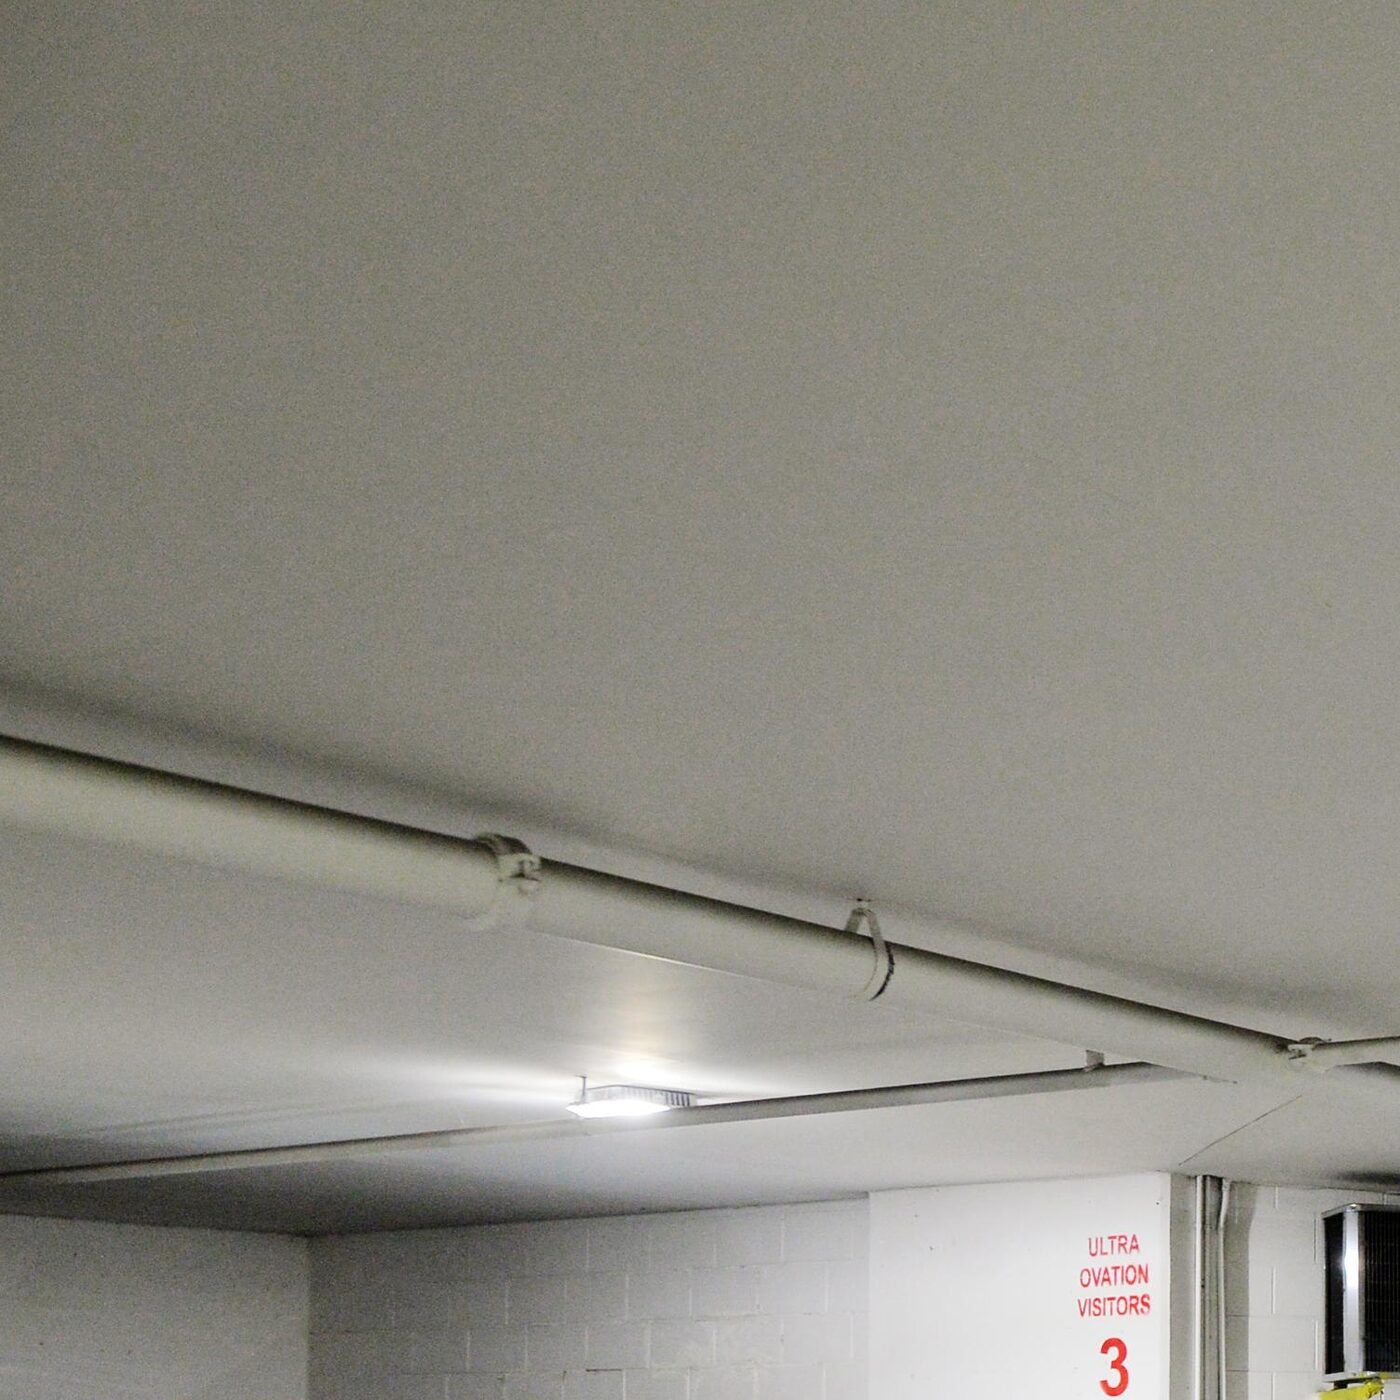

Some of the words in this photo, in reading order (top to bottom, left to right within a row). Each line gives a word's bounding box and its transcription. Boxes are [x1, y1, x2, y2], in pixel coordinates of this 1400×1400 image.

[1088, 1234, 1140, 1257] ULTRA
[1080, 1264, 1149, 1288] OVATION
[1078, 1294, 1151, 1317] VISITORS
[1100, 1337, 1129, 1397] 3
